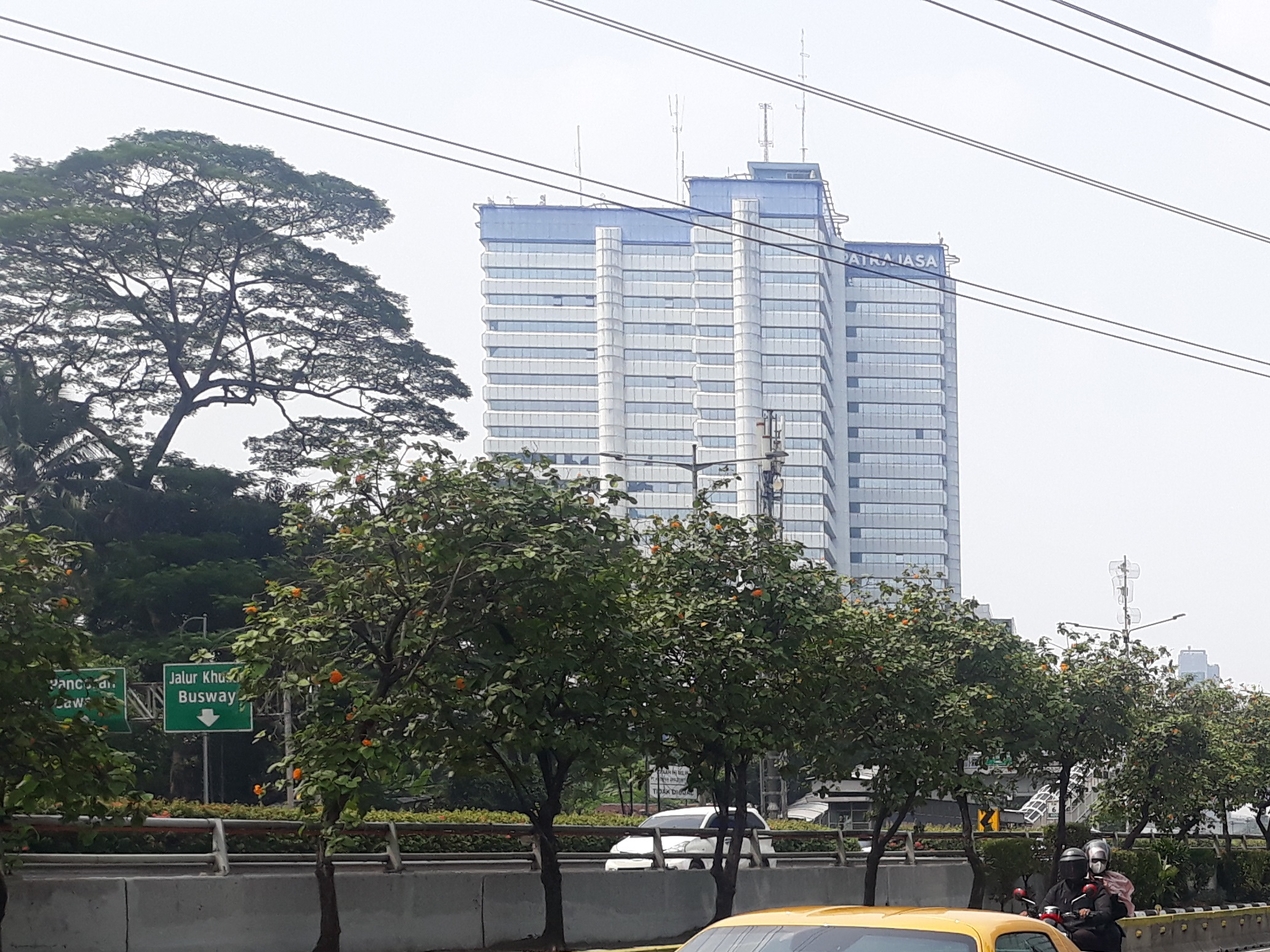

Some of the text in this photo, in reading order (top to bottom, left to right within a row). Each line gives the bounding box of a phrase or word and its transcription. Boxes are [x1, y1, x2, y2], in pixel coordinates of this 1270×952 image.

[169, 670, 240, 684] Jalur Khu
[179, 690, 236, 706] Busway
